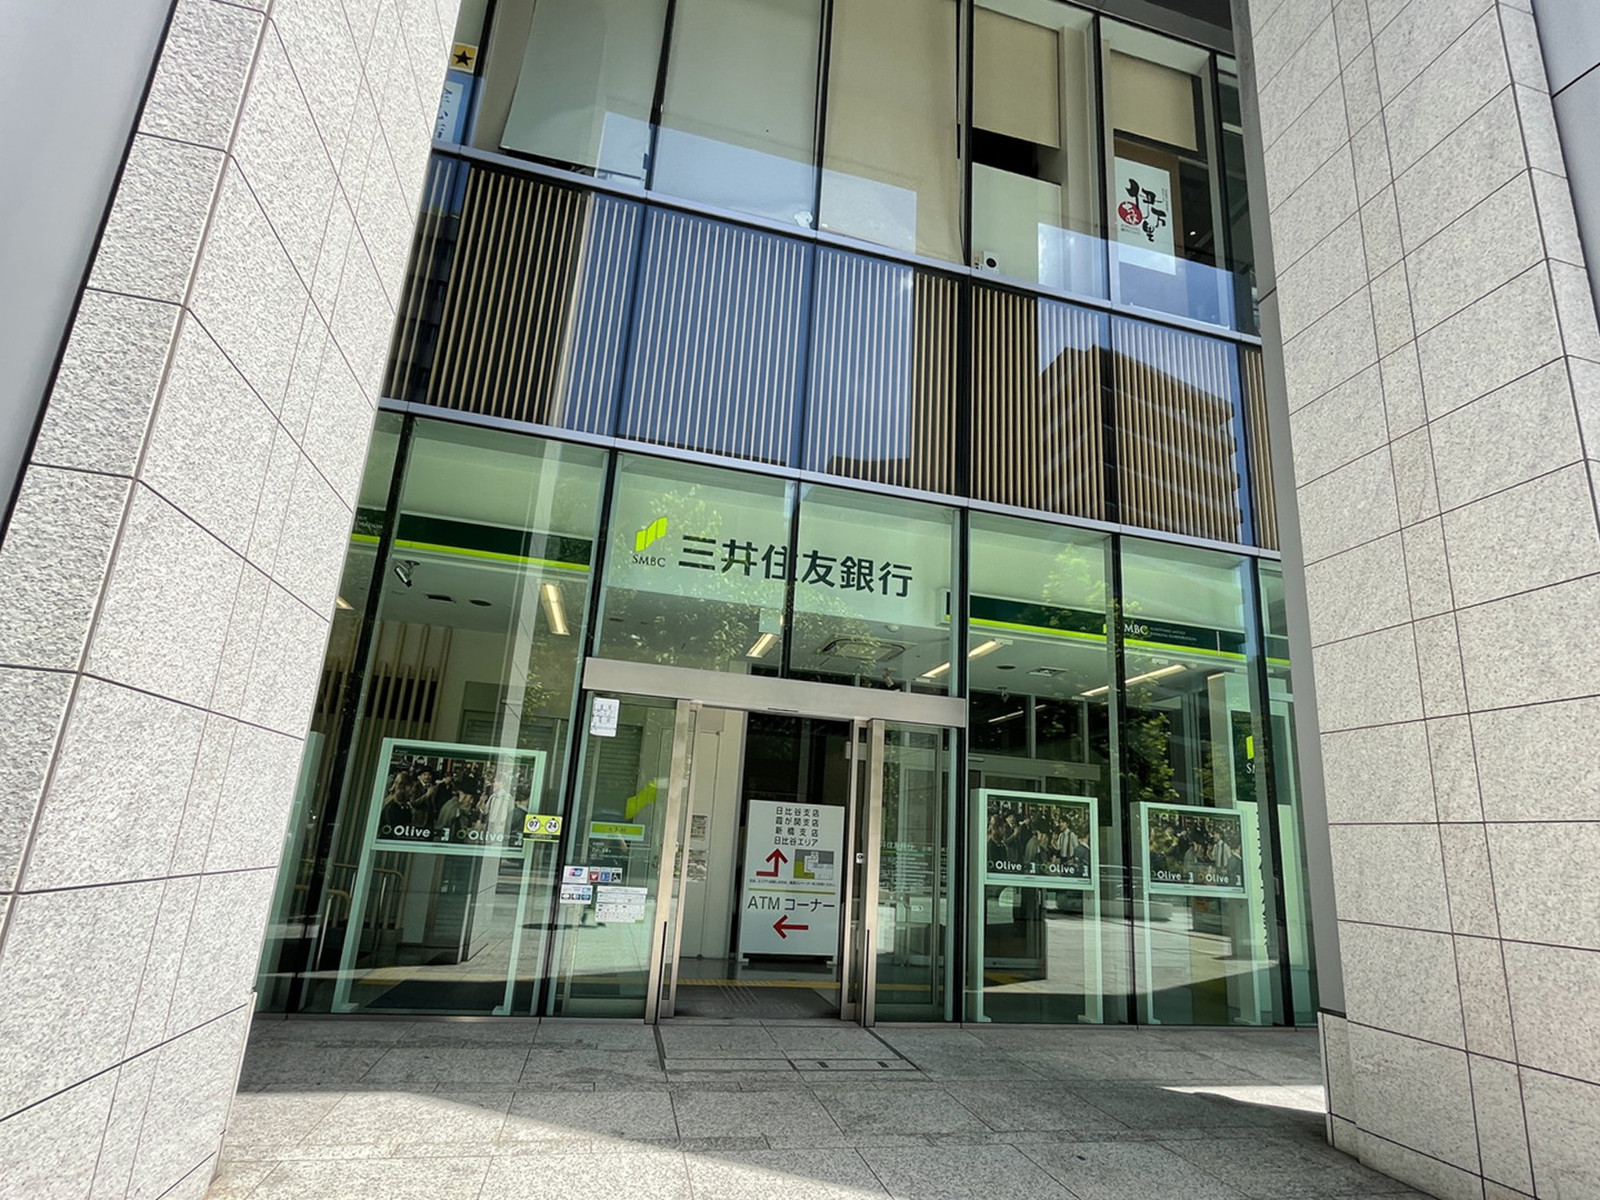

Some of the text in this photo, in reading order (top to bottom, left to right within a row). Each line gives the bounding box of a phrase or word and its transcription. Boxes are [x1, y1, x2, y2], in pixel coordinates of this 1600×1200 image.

[632, 554, 666, 567] SMBC
[678, 534, 913, 598] 三井住友銀行
[1123, 623, 1149, 635] MBC
[776, 806, 820, 818] 日比谷支店
[528, 821, 558, 830] 07 24
[775, 816, 819, 828] 霞が関支店
[393, 825, 431, 838] Olive
[468, 830, 504, 842] Olive
[775, 826, 819, 838] 新橋支店
[774, 836, 819, 847] 日比谷エリア
[995, 860, 1023, 871] Olive
[1048, 863, 1076, 875] Olive
[1156, 870, 1182, 881] Olive
[1205, 873, 1230, 884] Olive
[747, 896, 836, 912] ATM コーナー
